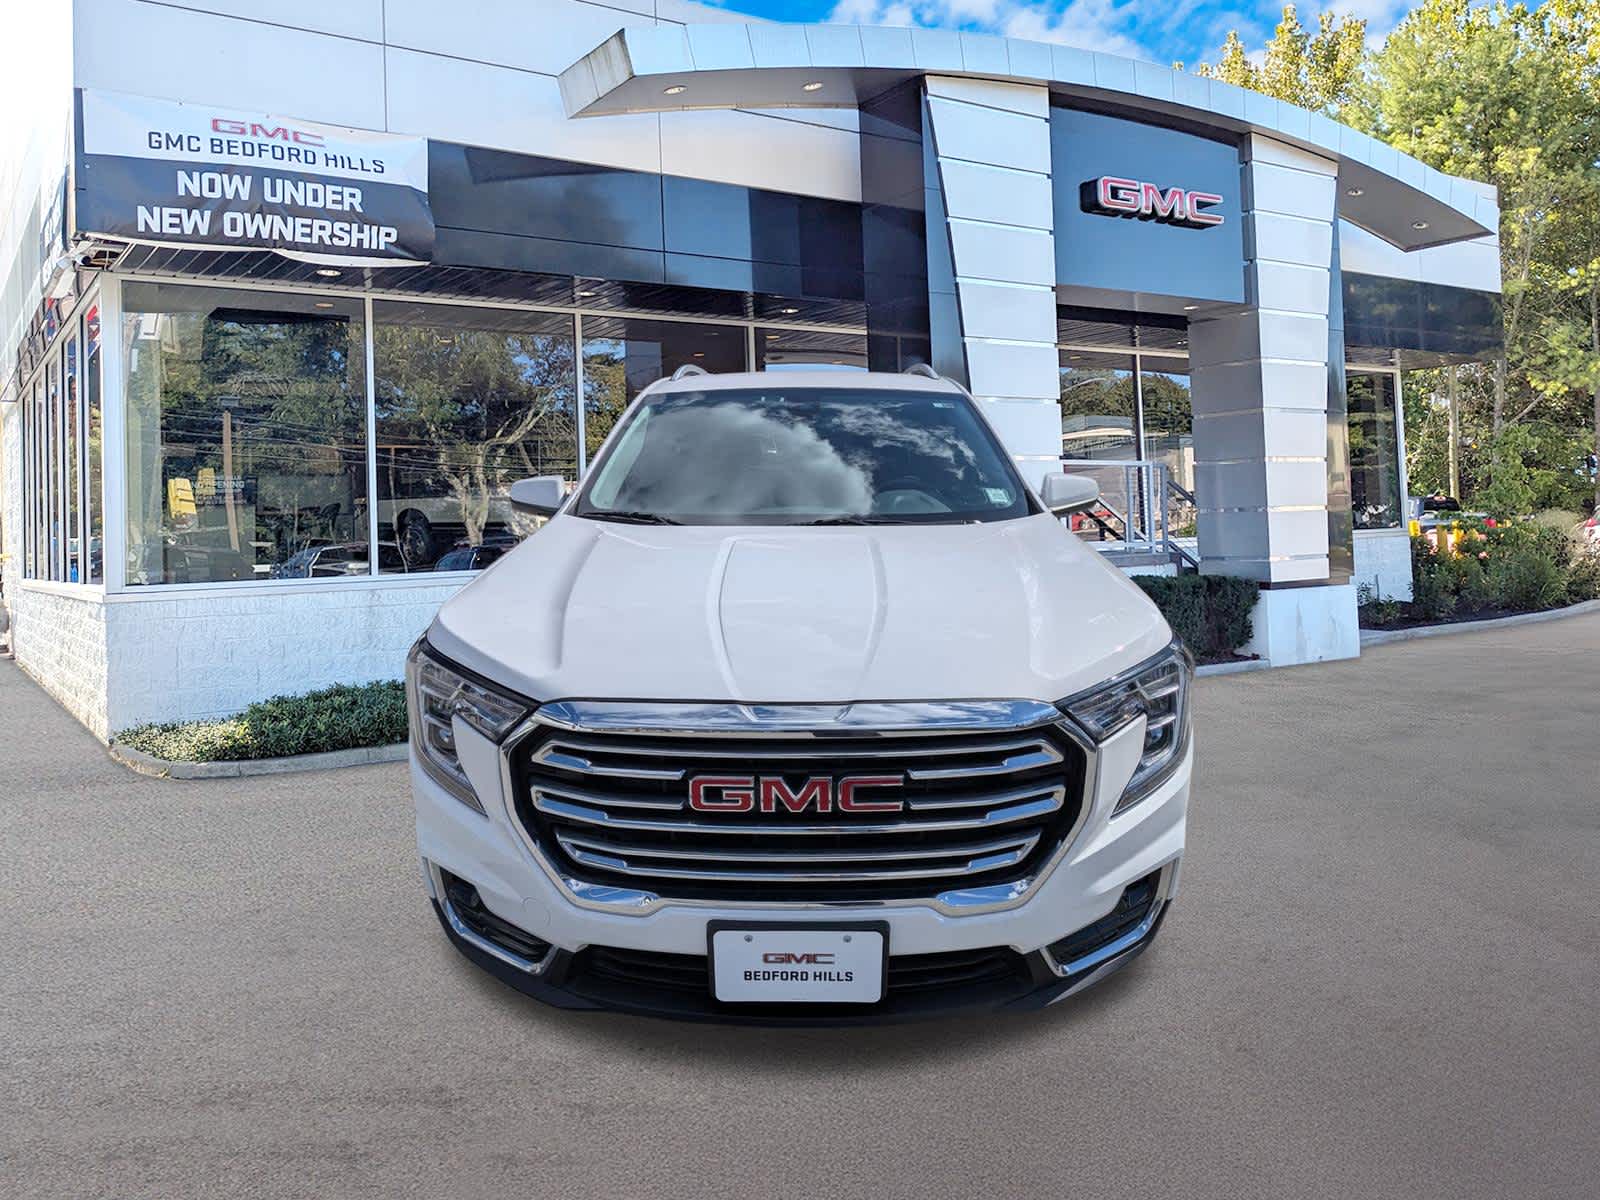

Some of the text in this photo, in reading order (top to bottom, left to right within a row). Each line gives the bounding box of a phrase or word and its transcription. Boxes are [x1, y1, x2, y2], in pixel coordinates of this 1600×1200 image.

[148, 131, 385, 174] GMC BEDFORD HILLS
[211, 118, 326, 148] GMC
[177, 170, 364, 213] NOW UNDER
[1098, 176, 1225, 225] GMC
[136, 205, 398, 250] NEW OWNERSHIP
[689, 775, 905, 813] GMC
[743, 970, 854, 982] BEDFORD HILLS
[762, 952, 835, 965] GMC
